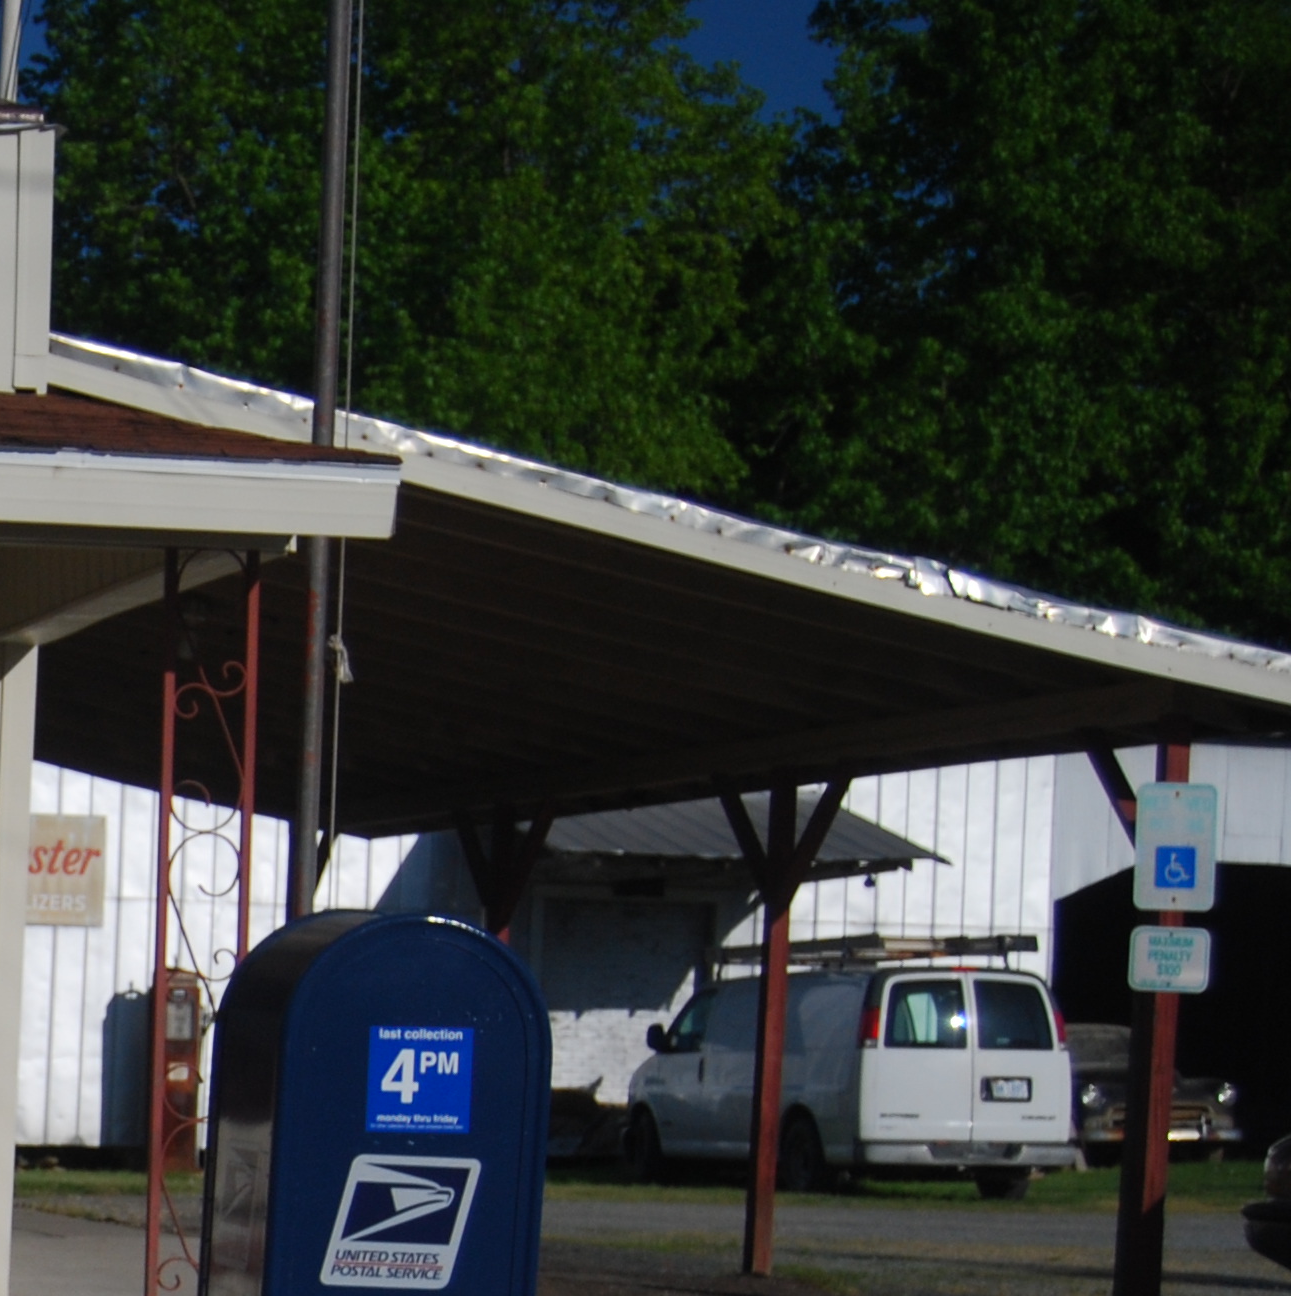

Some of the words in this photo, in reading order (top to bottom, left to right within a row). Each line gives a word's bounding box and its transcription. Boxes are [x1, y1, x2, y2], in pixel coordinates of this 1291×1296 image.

[379, 1027, 402, 1040] last
[404, 1028, 464, 1041] collection
[335, 1249, 389, 1262] UNITED
[391, 1251, 440, 1265] STATES
[330, 1264, 383, 1278] POSTAL
[385, 1267, 442, 1281] SERVICE
